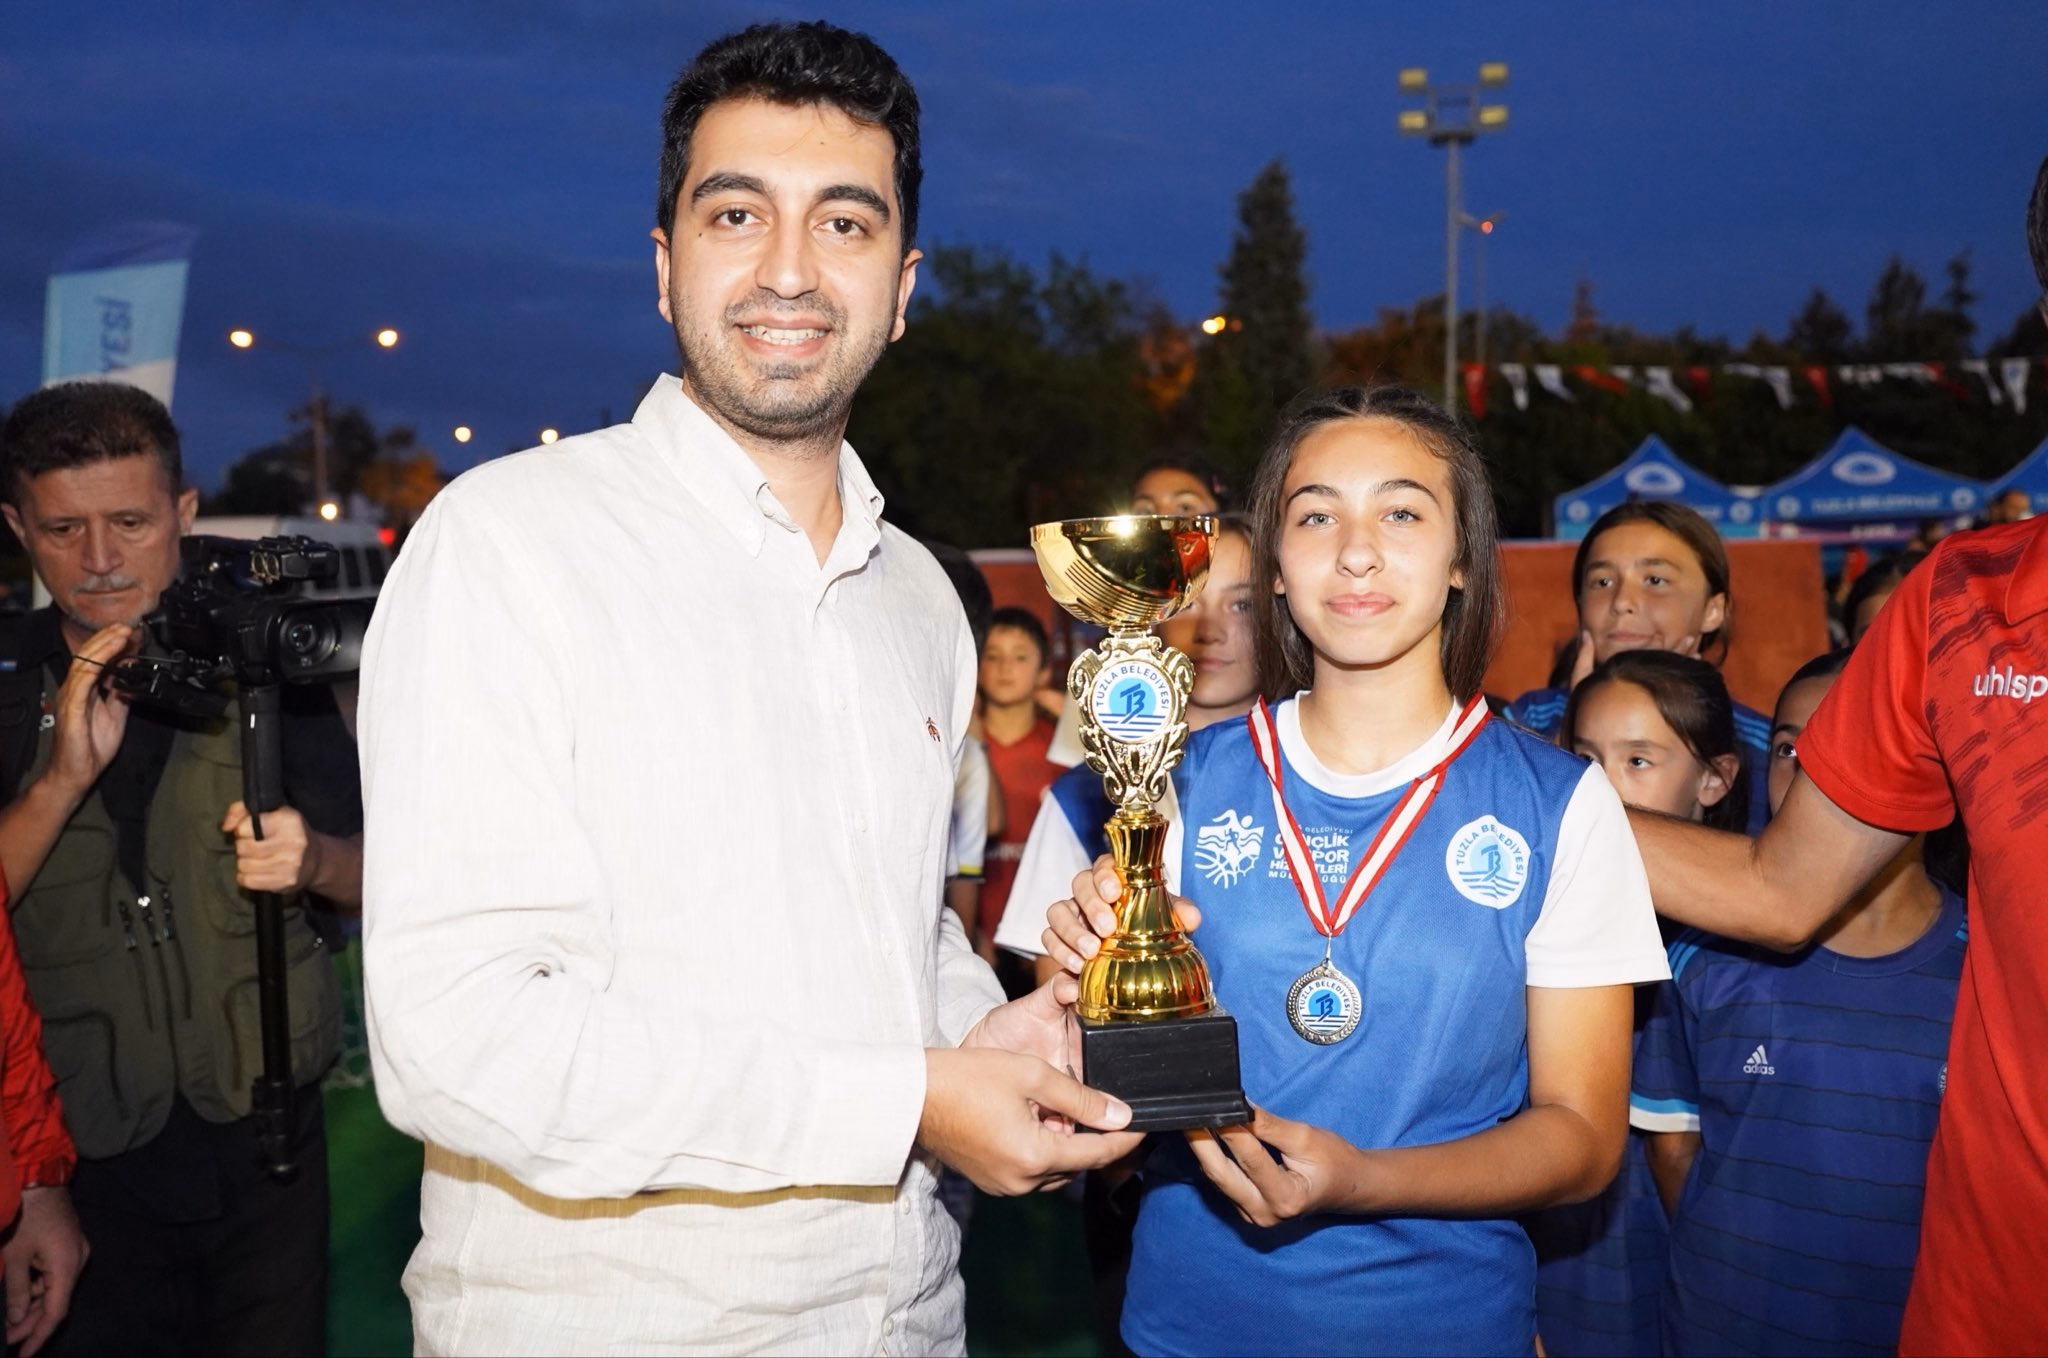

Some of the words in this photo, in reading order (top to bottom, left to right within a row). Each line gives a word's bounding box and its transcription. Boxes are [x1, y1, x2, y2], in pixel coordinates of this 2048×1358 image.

[1096, 672, 1118, 707] TUZLA
[1310, 849, 1350, 863] POR
[1456, 832, 1480, 866] TUZLA
[1300, 986, 1314, 1010] TUZLA
